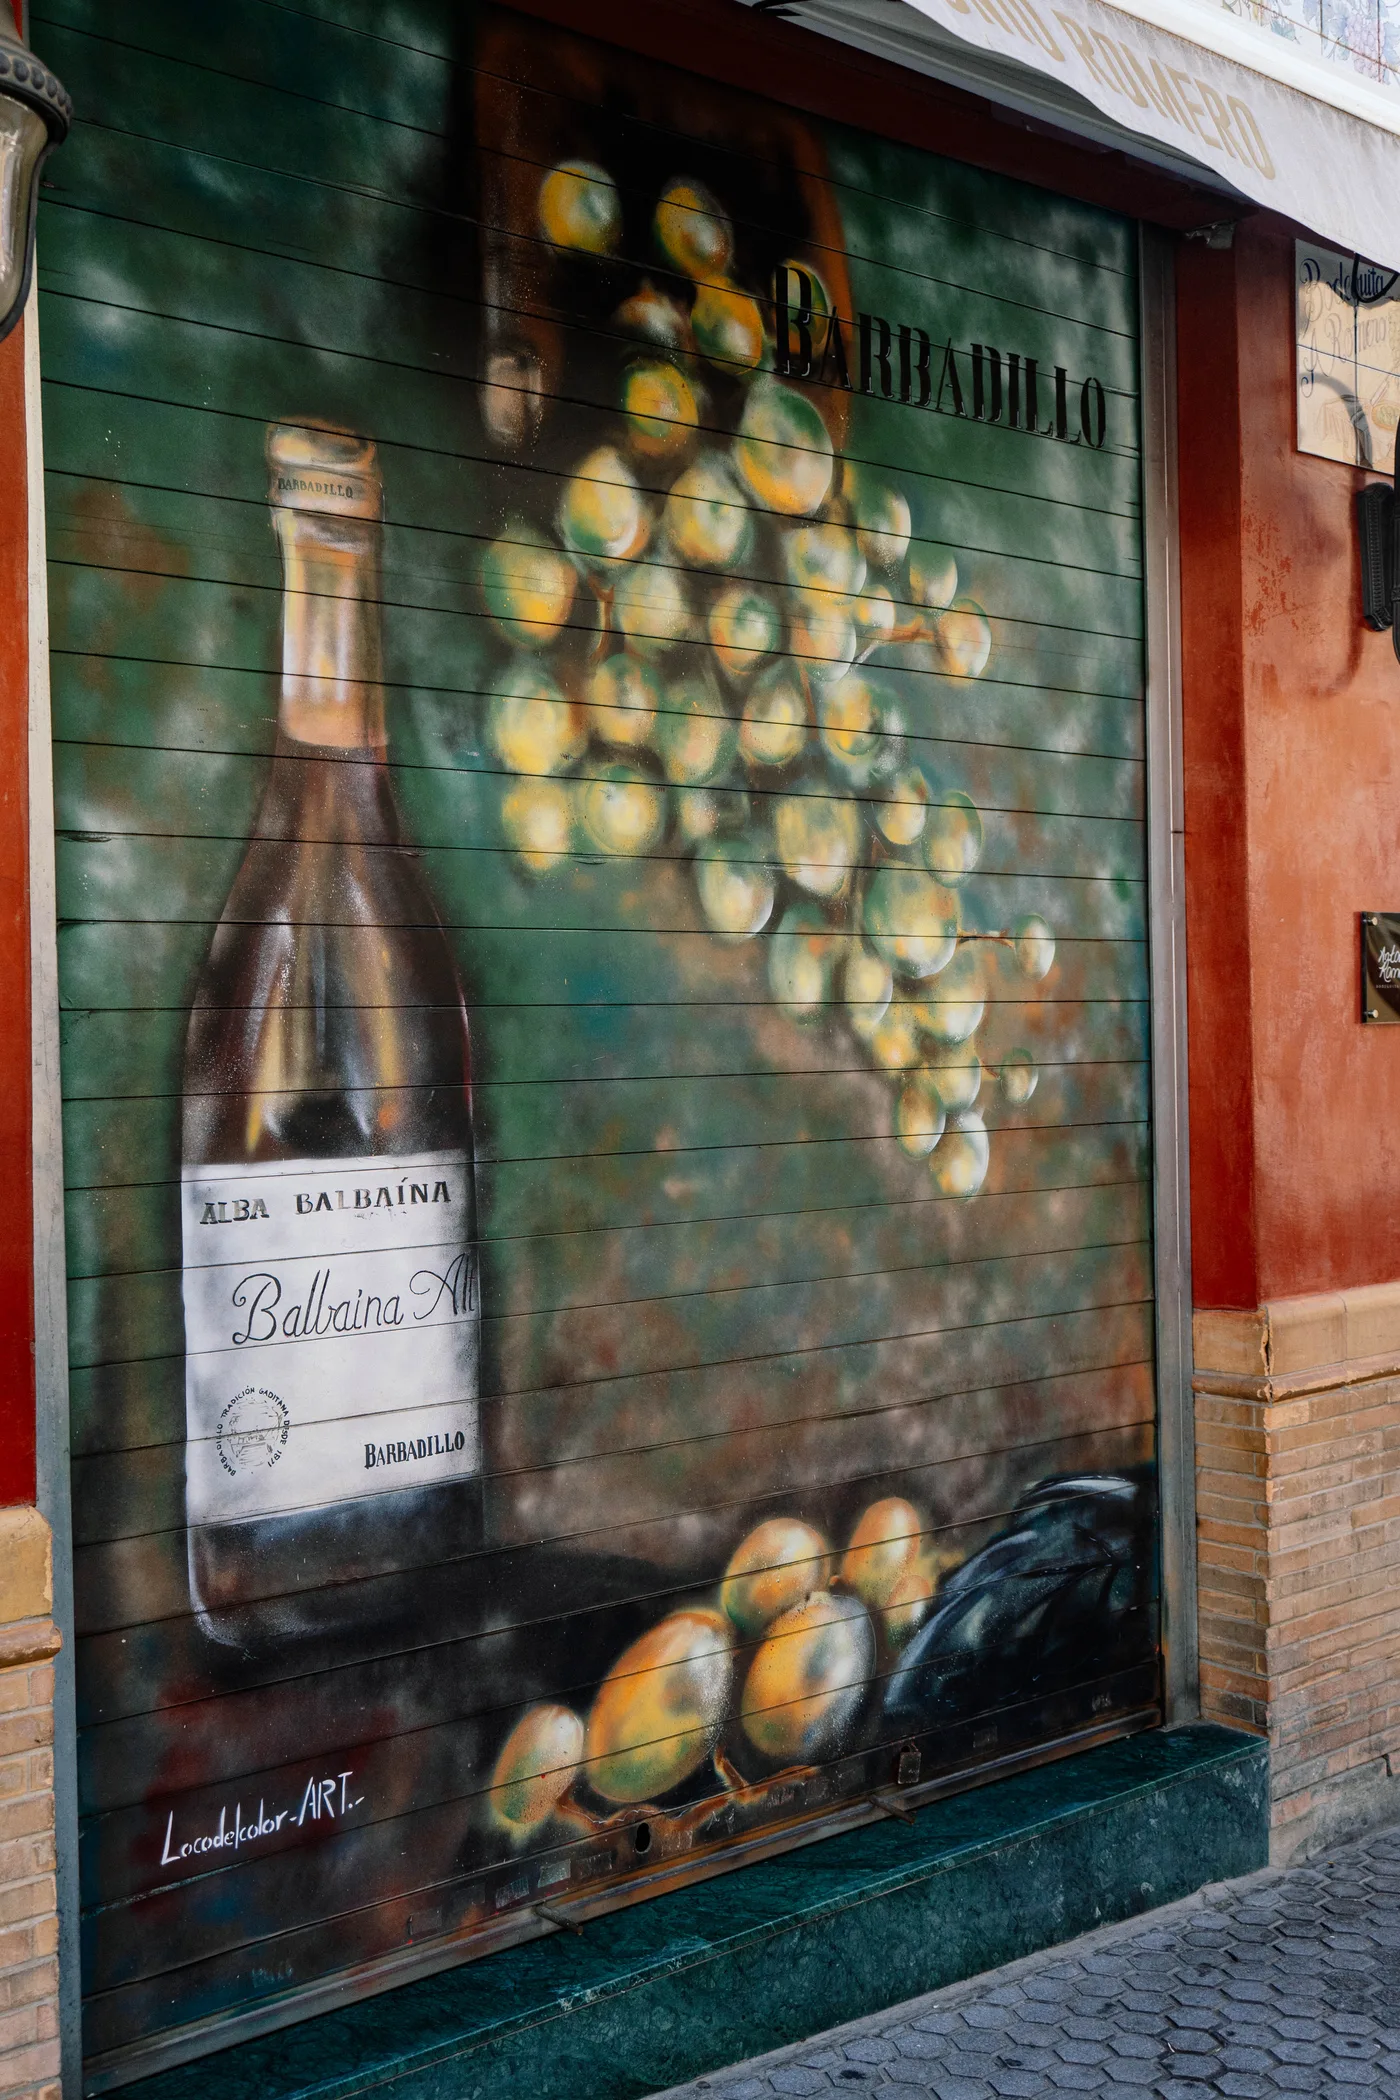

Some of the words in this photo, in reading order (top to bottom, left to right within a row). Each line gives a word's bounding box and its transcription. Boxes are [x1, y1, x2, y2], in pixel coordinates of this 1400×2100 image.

[1051, 8, 1276, 181] ROMERO
[1300, 257, 1386, 325] Bodeuita
[774, 264, 1107, 449] BARBADILLO
[277, 477, 354, 499] BARBADILLO
[199, 1198, 270, 1225] ALBA
[293, 1176, 452, 1216] BALBAÍNA
[258, 1387, 290, 1418] GADITANA
[267, 1449, 283, 1468] 1871
[364, 1430, 465, 1470] BARBADILLO
